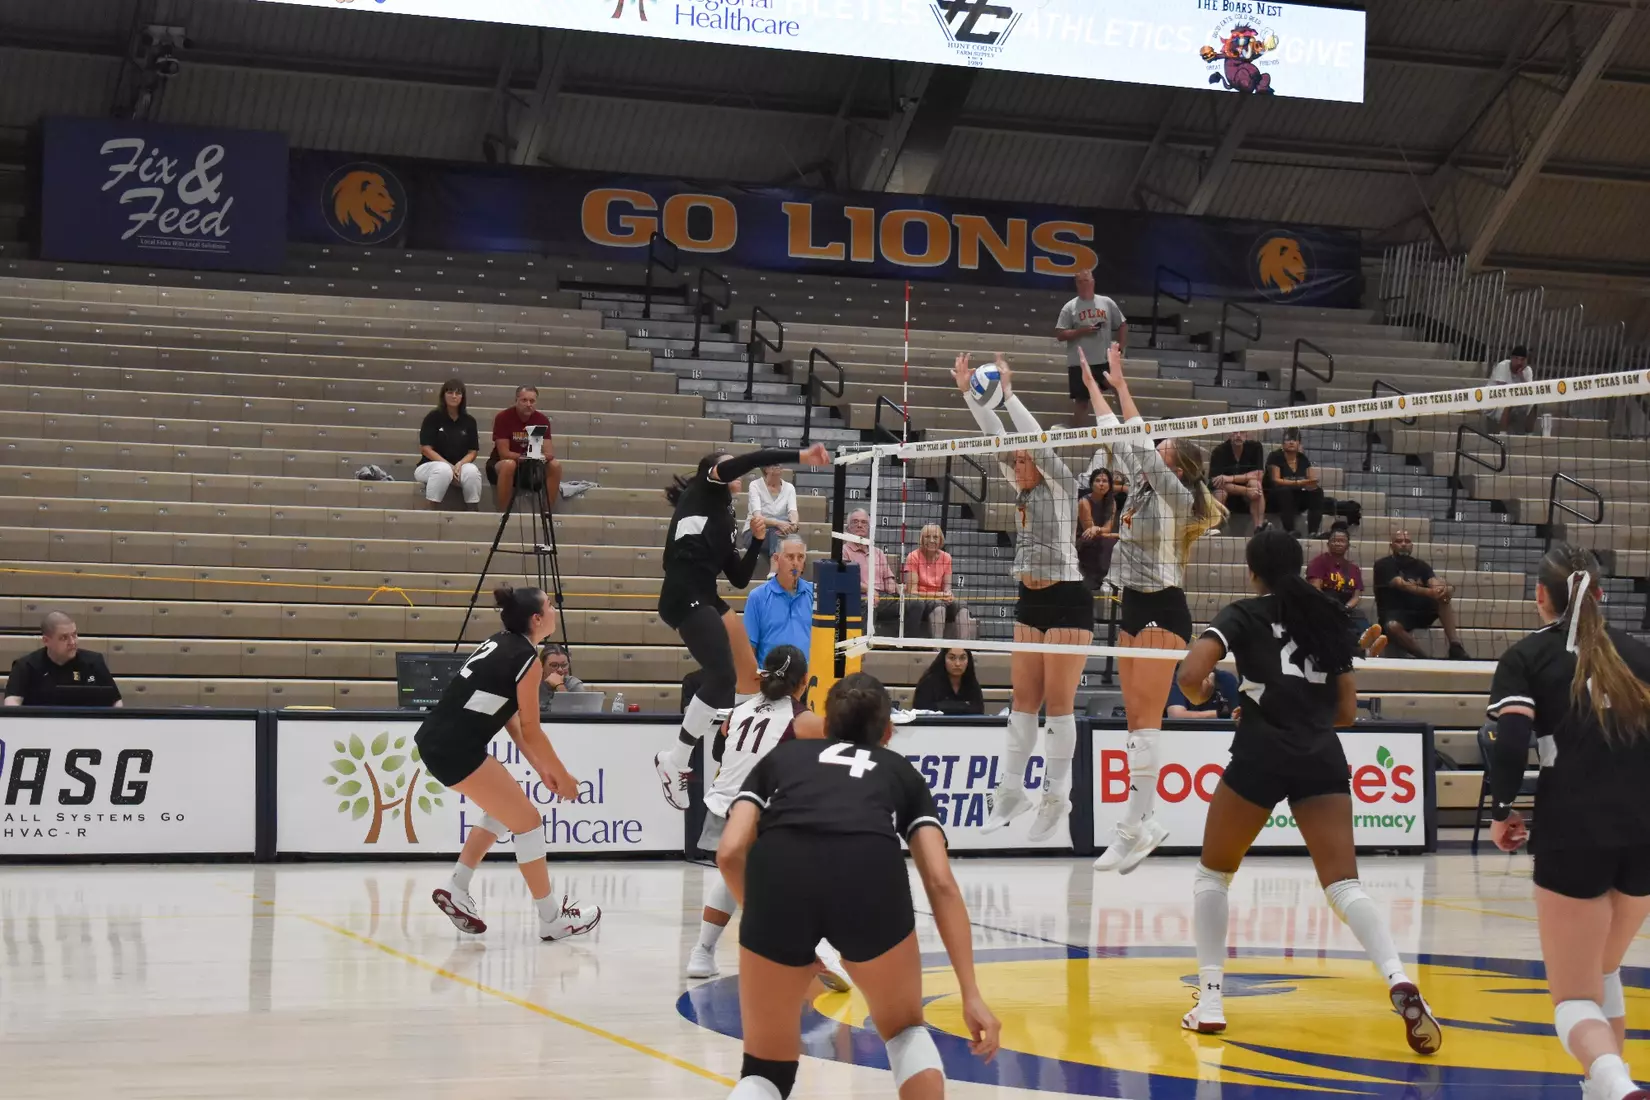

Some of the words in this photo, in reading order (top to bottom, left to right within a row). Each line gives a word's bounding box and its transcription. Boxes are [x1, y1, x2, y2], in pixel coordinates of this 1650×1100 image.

[1222, 0, 1253, 13] BOARS
[1256, 2, 1283, 17] NEST
[676, 4, 799, 36] Healthcare
[972, 44, 1004, 52] COUNTY
[100, 138, 178, 191] Fix
[178, 144, 224, 204] &
[119, 187, 233, 239] Feed
[581, 188, 738, 253] GO
[782, 202, 1099, 276] LIONS
[1489, 387, 1507, 399] EAST
[1509, 385, 1533, 397] TEXAS
[1573, 381, 1593, 392] EAST
[1595, 377, 1620, 390] TEXAS
[1341, 404, 1356, 415] EAST
[1358, 402, 1377, 412] TEXAS
[1412, 396, 1428, 406] EAST
[1430, 394, 1452, 404] TEXAS
[1000, 607, 1007, 618] 6
[1081, 677, 1087, 688] 4
[736, 716, 771, 754] 11
[818, 742, 878, 779] 4
[5, 748, 154, 805] ASG
